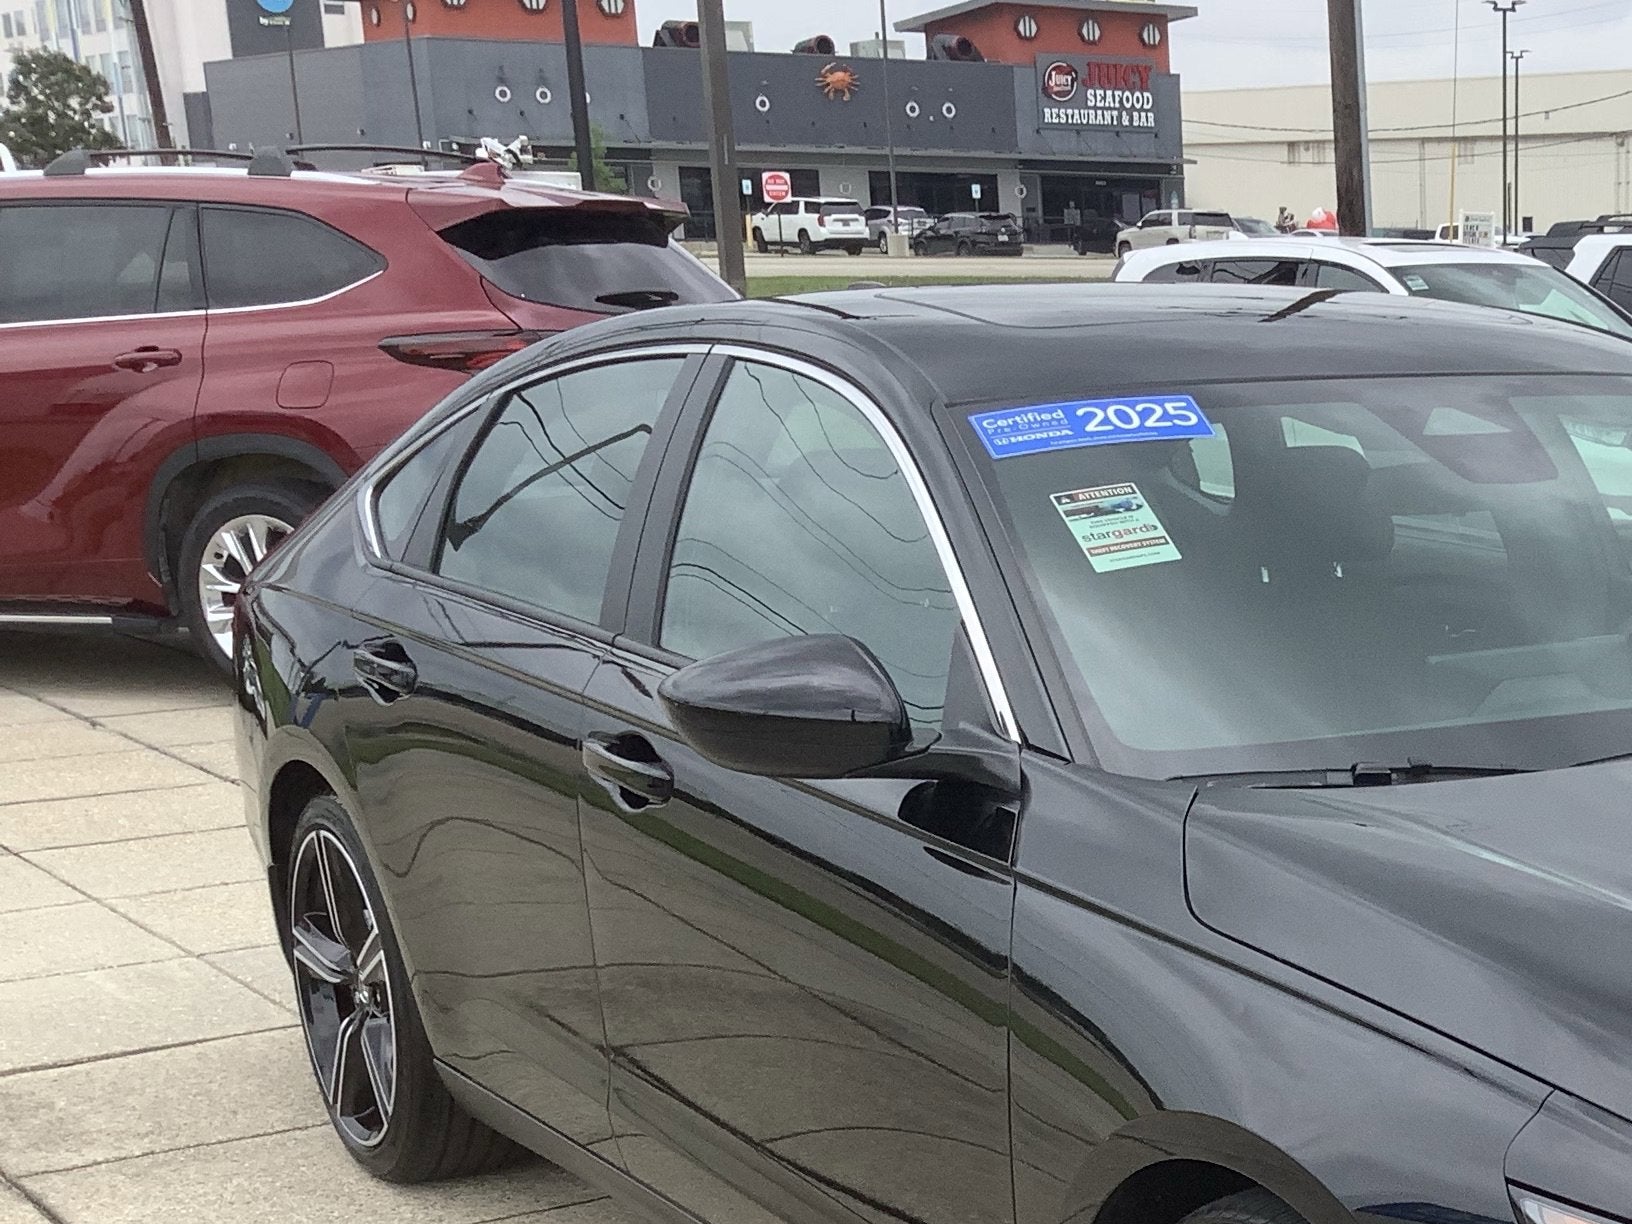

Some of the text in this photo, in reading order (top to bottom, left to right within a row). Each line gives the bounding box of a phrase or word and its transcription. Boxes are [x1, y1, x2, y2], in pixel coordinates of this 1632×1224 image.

[1082, 62, 1153, 90] JUICY
[1087, 89, 1153, 109] SEAFOOD
[1043, 108, 1155, 127] RESTAURANT & BAR
[982, 409, 1065, 429] Certified
[987, 418, 1069, 435] Pre-Owned
[1076, 402, 1198, 432] 2025
[1009, 429, 1074, 443] HONDA
[1078, 486, 1133, 501] ATTENTION
